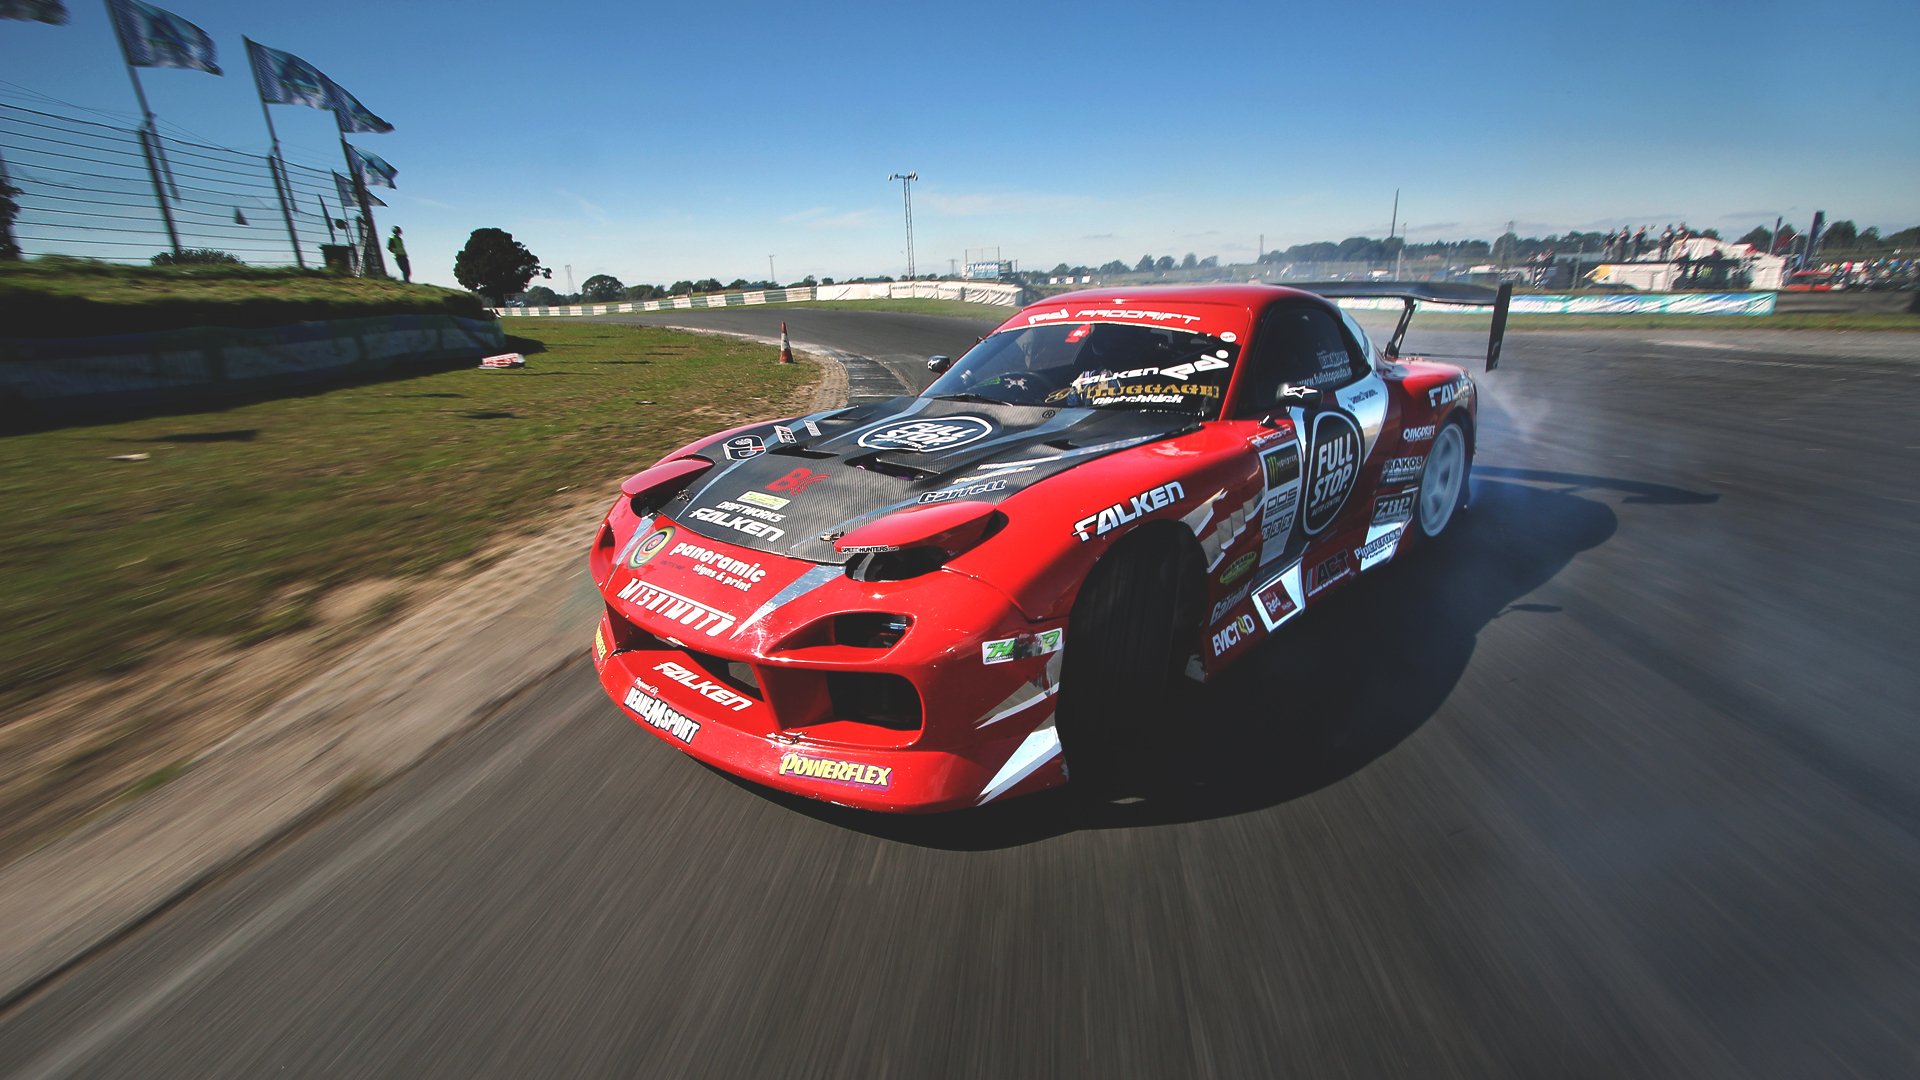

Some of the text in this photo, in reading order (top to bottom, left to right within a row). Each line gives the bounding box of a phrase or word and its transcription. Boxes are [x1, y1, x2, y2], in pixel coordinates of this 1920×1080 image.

[899, 423, 977, 437] FULL
[1317, 432, 1353, 478] FULL
[688, 507, 785, 542] FALKEN
[716, 501, 787, 522] DRIFTWORKS
[1073, 481, 1185, 541] FALKEN
[1354, 527, 1402, 560] Pipercross
[669, 541, 766, 583] panoramic
[692, 564, 717, 578] signs
[715, 572, 726, 582] &
[722, 576, 752, 592] print
[652, 661, 753, 712] FALKEN
[779, 752, 891, 786] POWERFLEX
